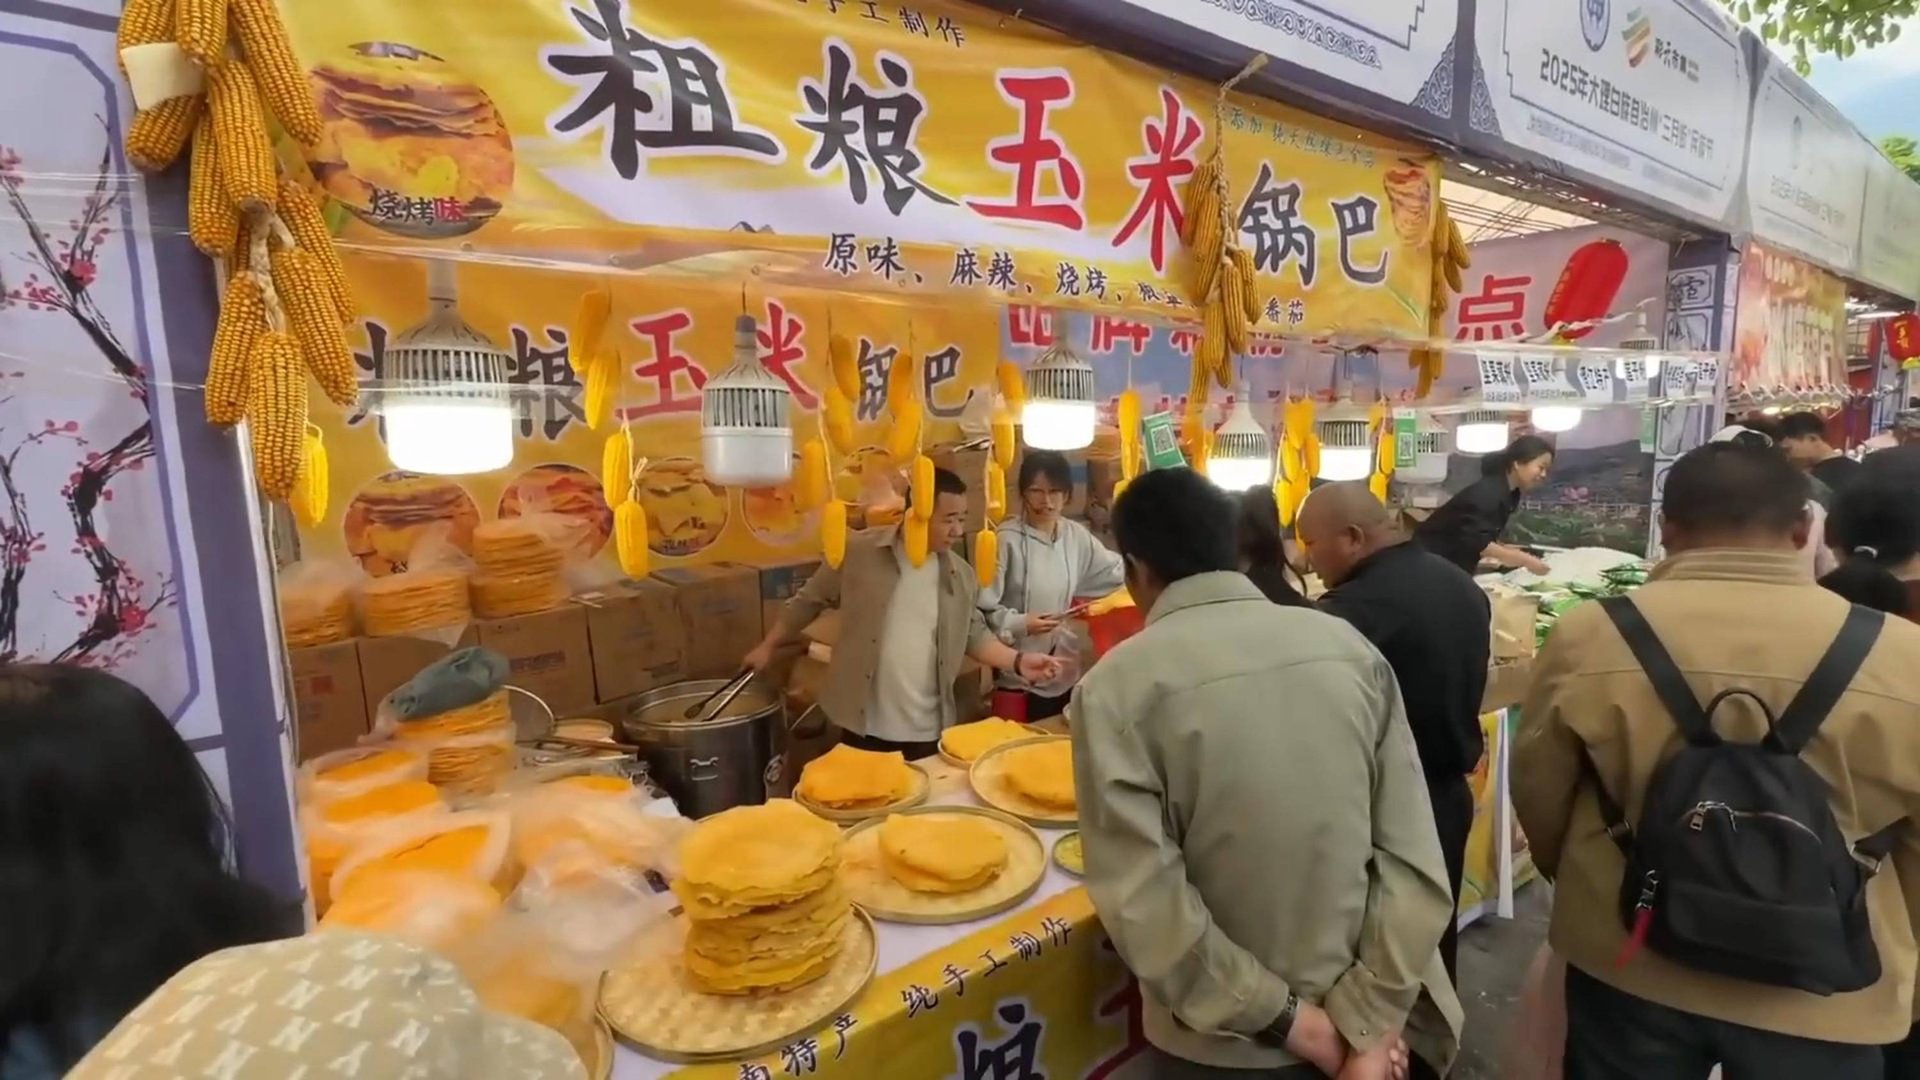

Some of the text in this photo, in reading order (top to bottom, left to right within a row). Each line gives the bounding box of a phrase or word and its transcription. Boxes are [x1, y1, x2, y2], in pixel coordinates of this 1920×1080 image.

[547, 0, 1389, 286] 粗粮玉米锅巴
[369, 188, 470, 226] 烧烤味
[1264, 296, 1305, 326] 番茄
[1458, 274, 1532, 342] 点
[901, 915, 1073, 1018] 纯手工制作
